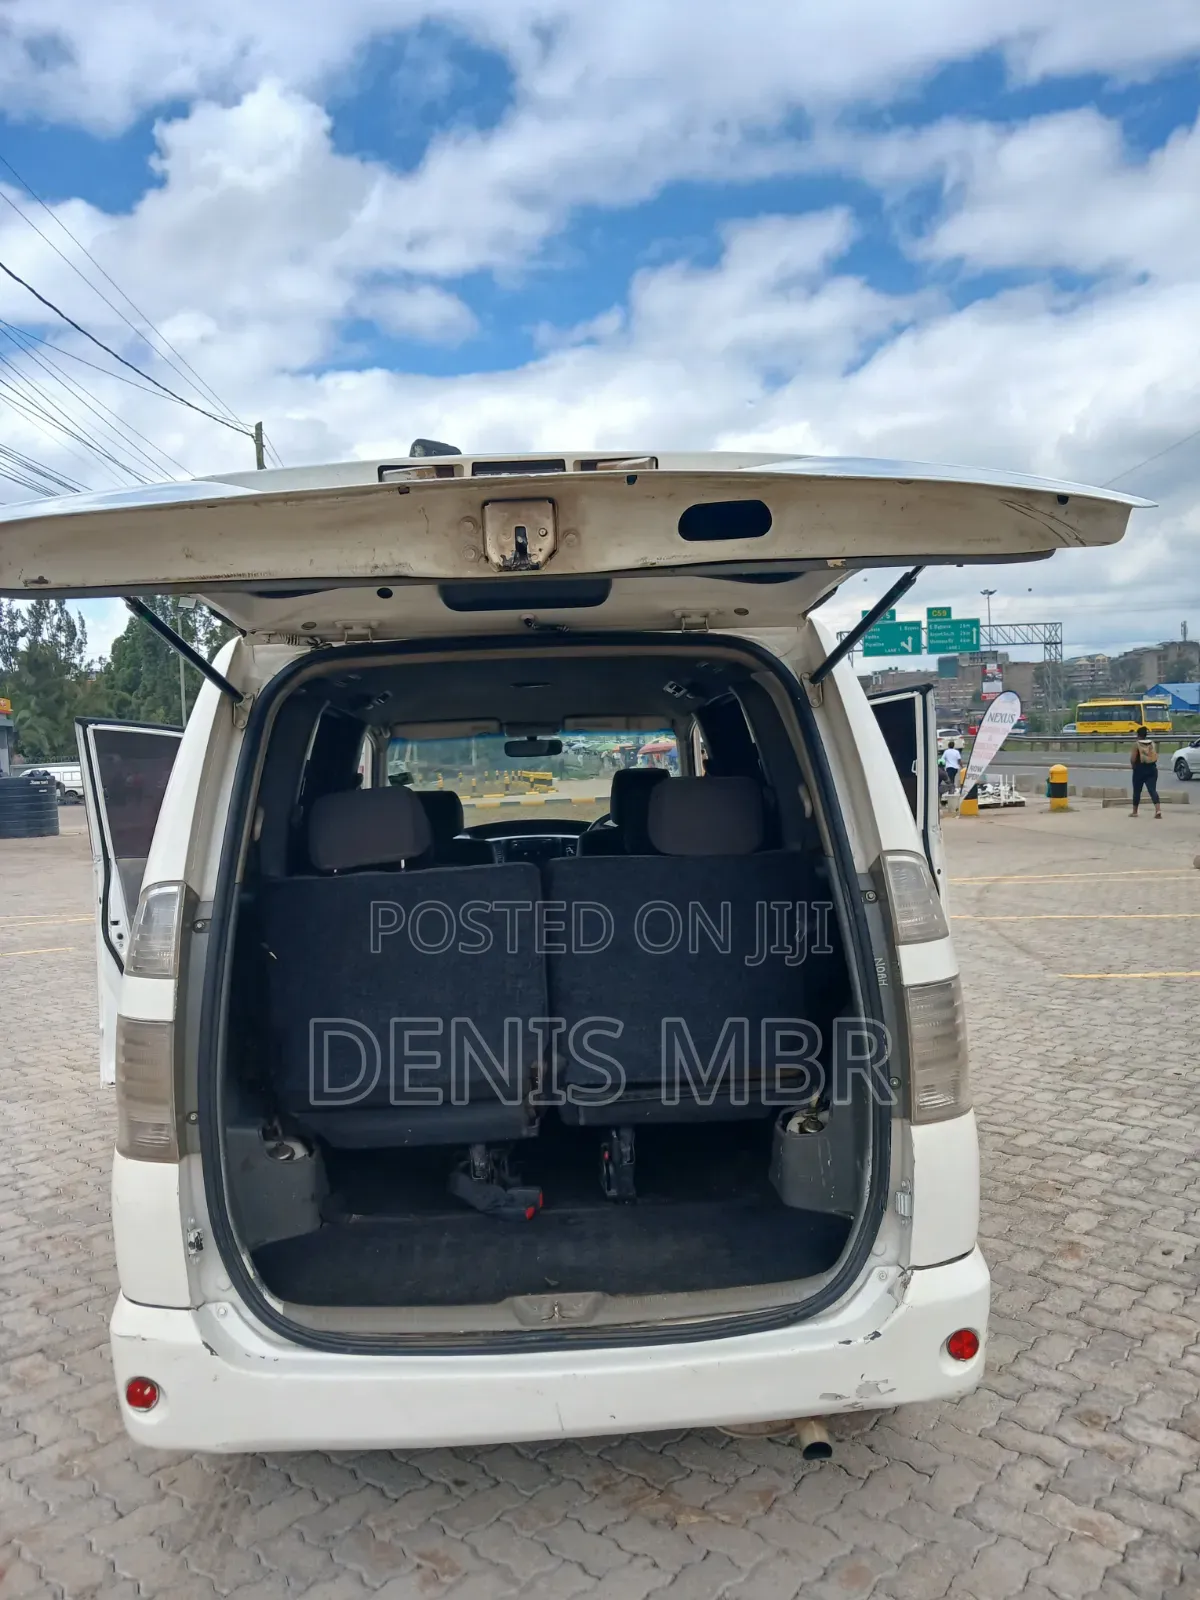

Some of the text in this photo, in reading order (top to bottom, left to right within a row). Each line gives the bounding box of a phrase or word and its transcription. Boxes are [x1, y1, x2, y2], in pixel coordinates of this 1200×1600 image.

[987, 712, 1016, 724] NEXUS
[969, 765, 983, 773] NOW
[874, 957, 888, 986] NOAH
